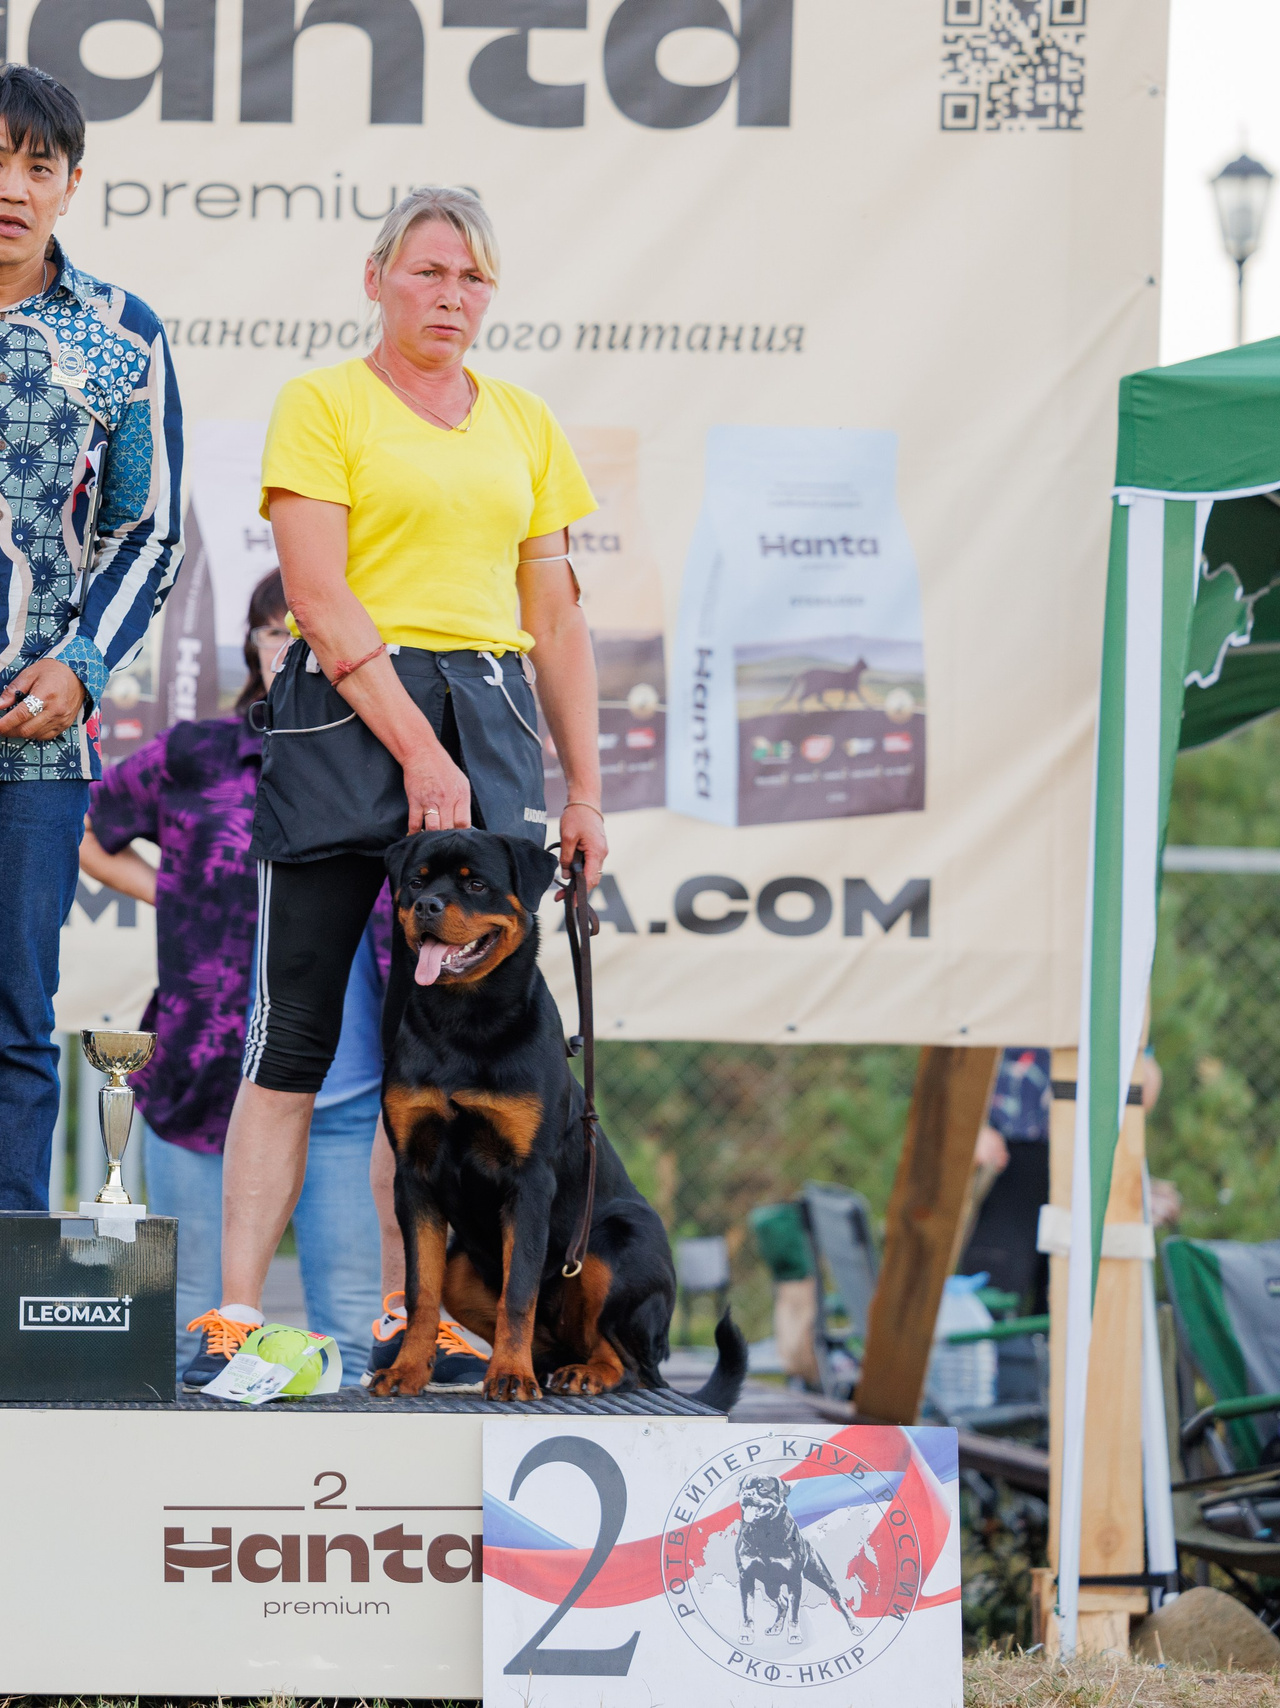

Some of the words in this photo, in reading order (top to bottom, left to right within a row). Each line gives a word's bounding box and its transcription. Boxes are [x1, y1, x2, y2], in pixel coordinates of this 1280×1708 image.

[574, 319, 806, 354] питания
[758, 532, 879, 559] Hanta
[693, 648, 713, 799] Hanta
[313, 1471, 348, 1510] 2
[667, 1443, 762, 1619] РОТВЕЙЛЕР
[782, 1439, 869, 1482] КЛУБ
[875, 1487, 918, 1622] РОССИИ
[163, 1523, 484, 1584] Hanta
[503, 1435, 641, 1677] 2
[263, 1596, 391, 1618] premium
[727, 1645, 866, 1684] РКФ-НКПР
